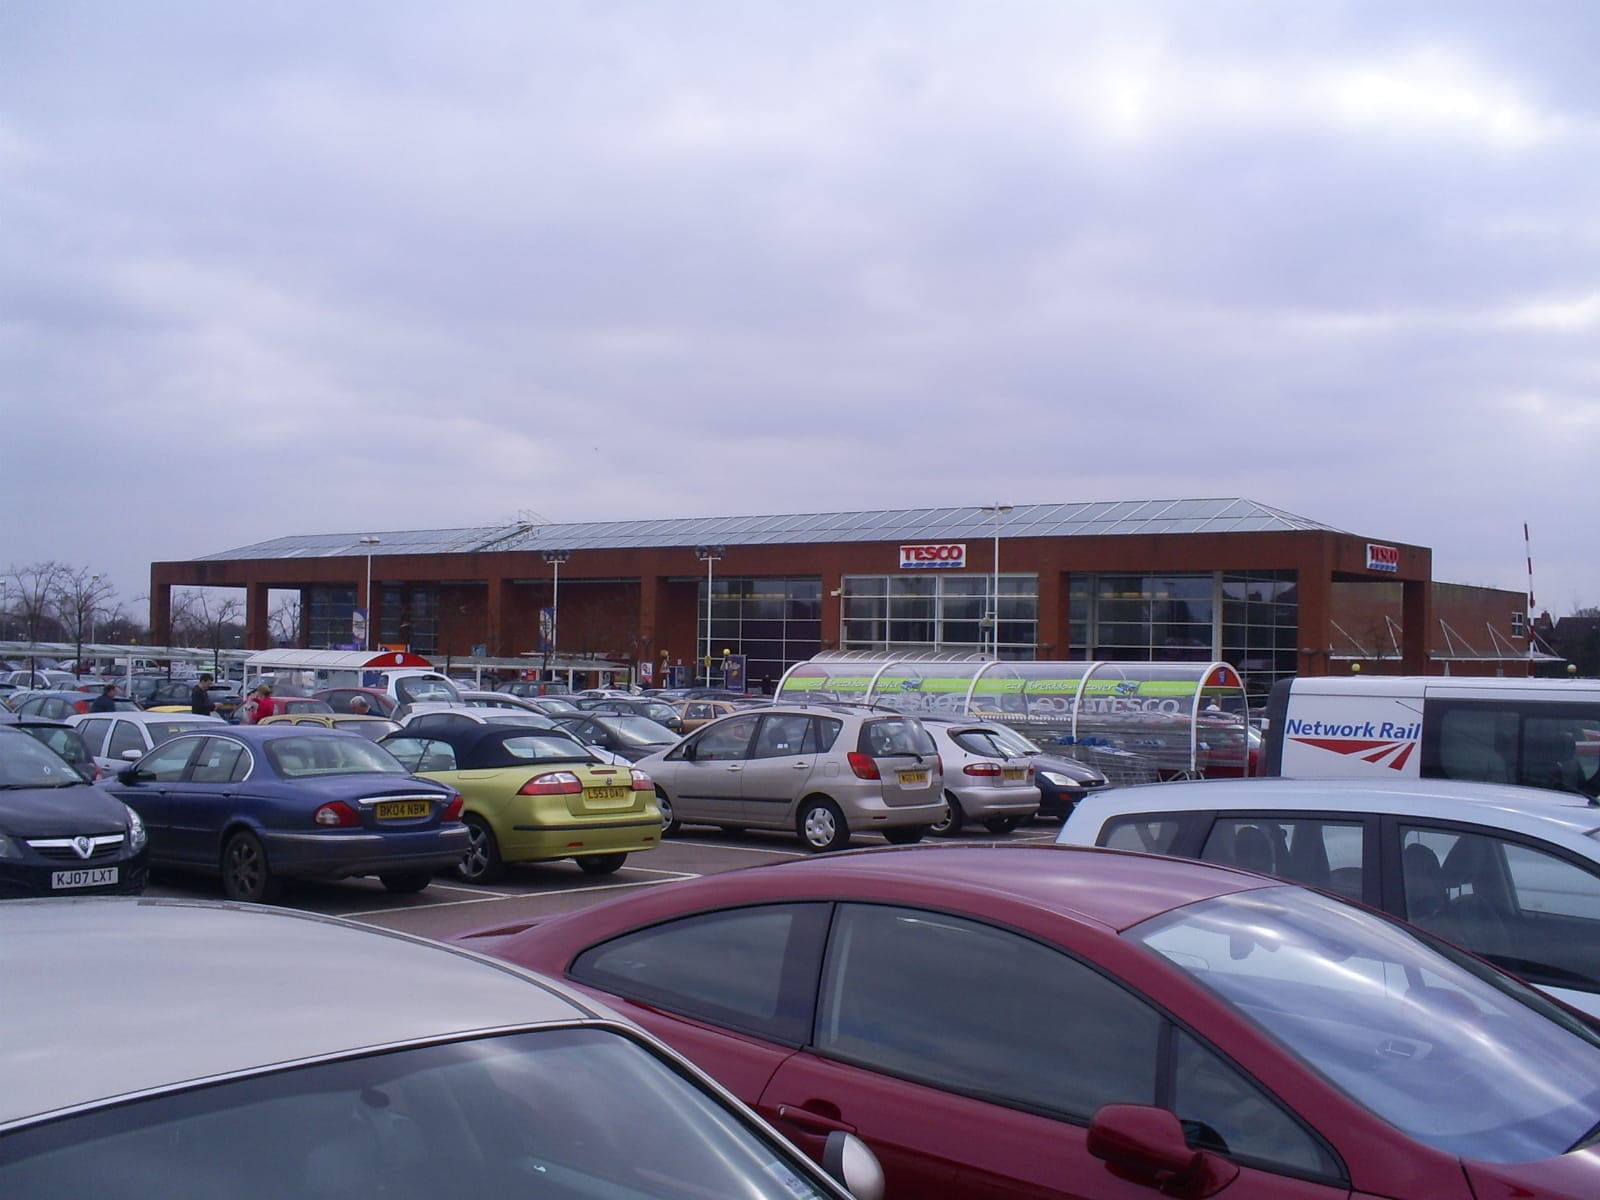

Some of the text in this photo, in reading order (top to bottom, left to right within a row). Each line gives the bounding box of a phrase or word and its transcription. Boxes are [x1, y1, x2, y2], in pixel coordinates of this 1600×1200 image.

[901, 545, 963, 561] TESCO
[1286, 719, 1421, 740] Network Rail
[380, 804, 404, 817] BK04
[57, 870, 113, 886] KJ07 LXT
